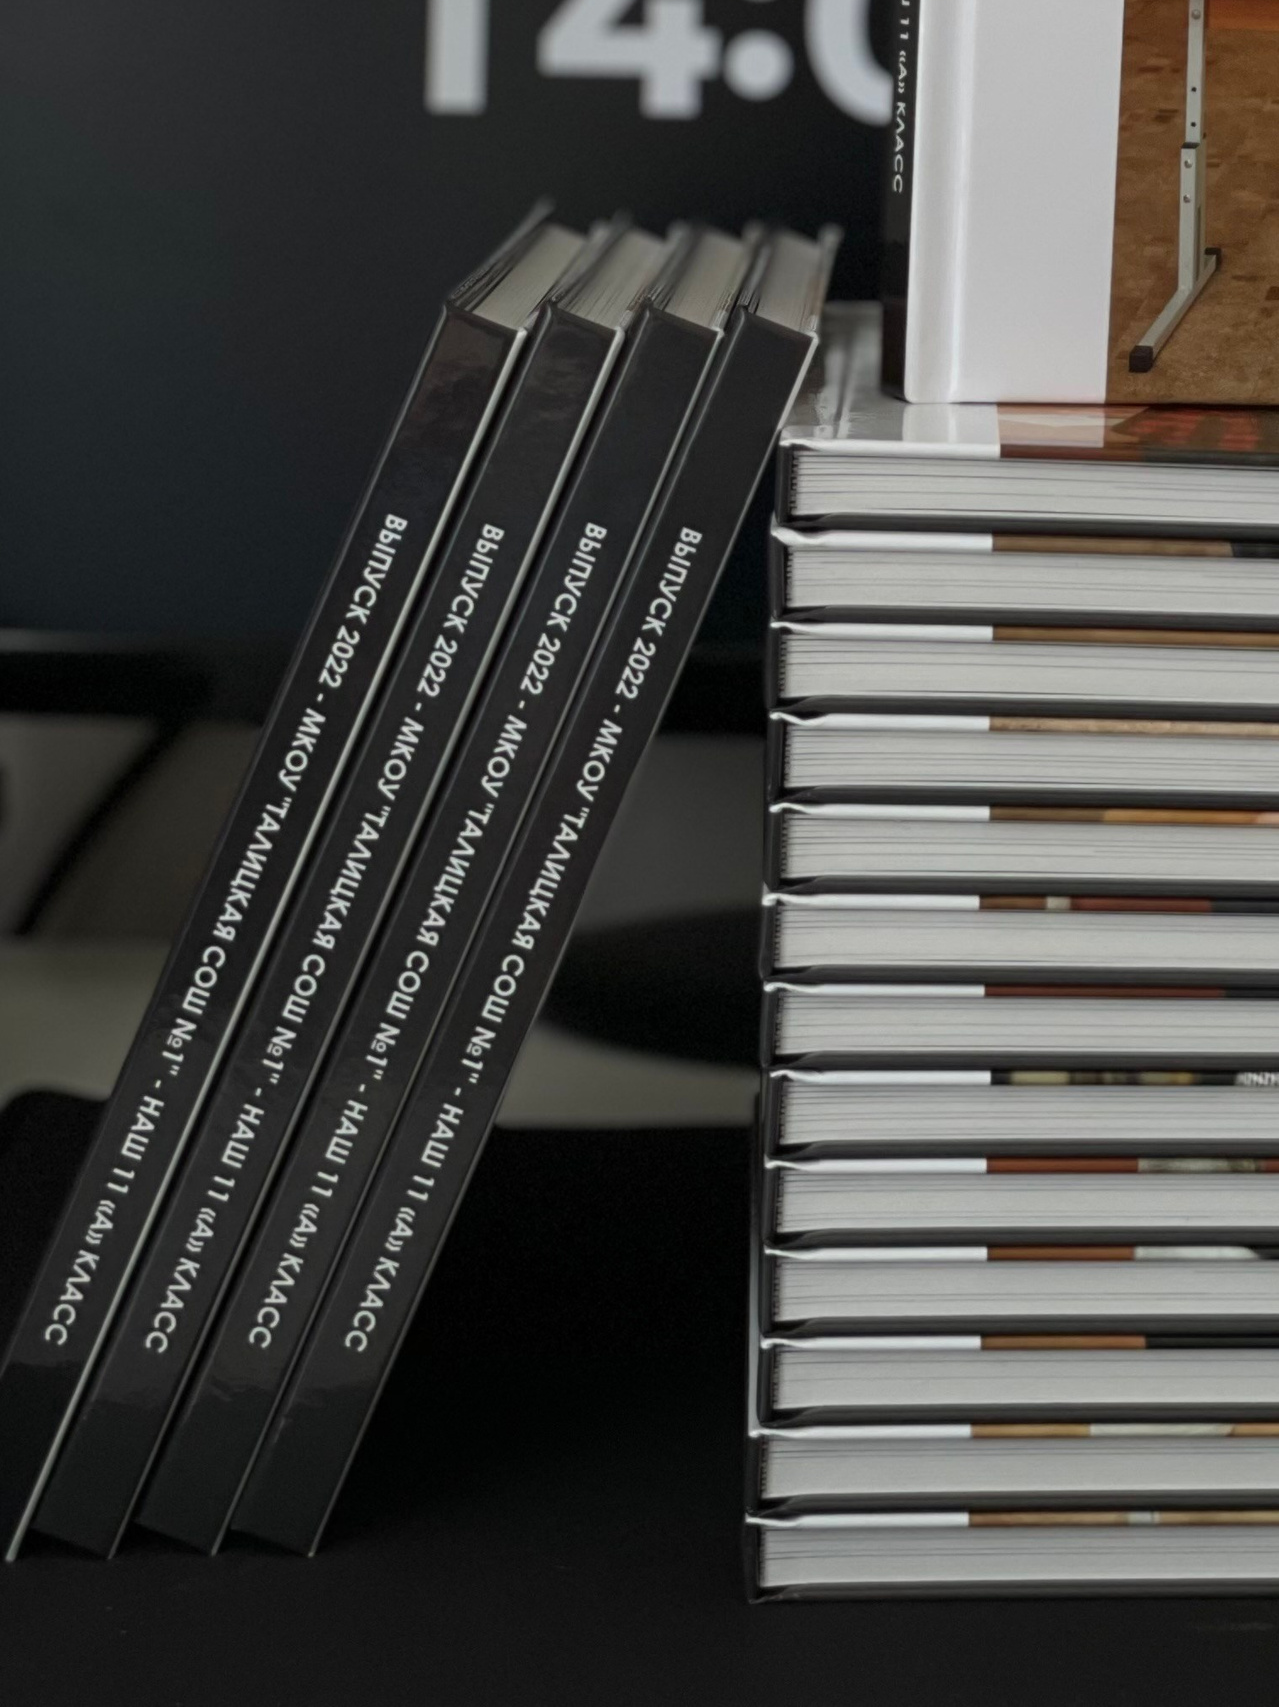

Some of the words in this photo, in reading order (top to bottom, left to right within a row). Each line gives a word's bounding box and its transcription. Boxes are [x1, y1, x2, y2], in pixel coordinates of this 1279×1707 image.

[900, 18, 910, 40] 11
[893, 102, 906, 193] КЛАСС
[345, 514, 408, 624] ВЫПУСК
[443, 523, 505, 633] ВЫПУСК
[546, 522, 607, 632] ВЫПУСК
[641, 527, 702, 636] ВЫПУСК
[318, 625, 360, 688] 2022
[416, 634, 458, 697] 2022
[520, 633, 561, 695] 2022
[615, 637, 656, 699] 2022
[278, 708, 326, 792] МКОУ
[377, 717, 424, 801] МКОУ
[481, 714, 527, 798] МКОУ
[576, 719, 623, 802] МКОУ
[182, 946, 226, 1015] СОШ
[282, 954, 326, 1023] СОШ
[386, 950, 430, 1019] СОШ
[481, 954, 525, 1023] СОШ
[121, 1095, 165, 1161] НАШ
[221, 1103, 265, 1169] НАШ
[325, 1099, 368, 1164] НАШ
[421, 1103, 464, 1168] НАШ
[107, 1168, 135, 1194] 11
[207, 1176, 235, 1202] 11
[311, 1171, 339, 1198] 11
[407, 1175, 435, 1201] 11
[44, 1250, 99, 1346] КЛАСС
[145, 1257, 201, 1354] КЛАСС
[248, 1252, 304, 1348] КЛАСС
[344, 1256, 400, 1352] КЛАСС
